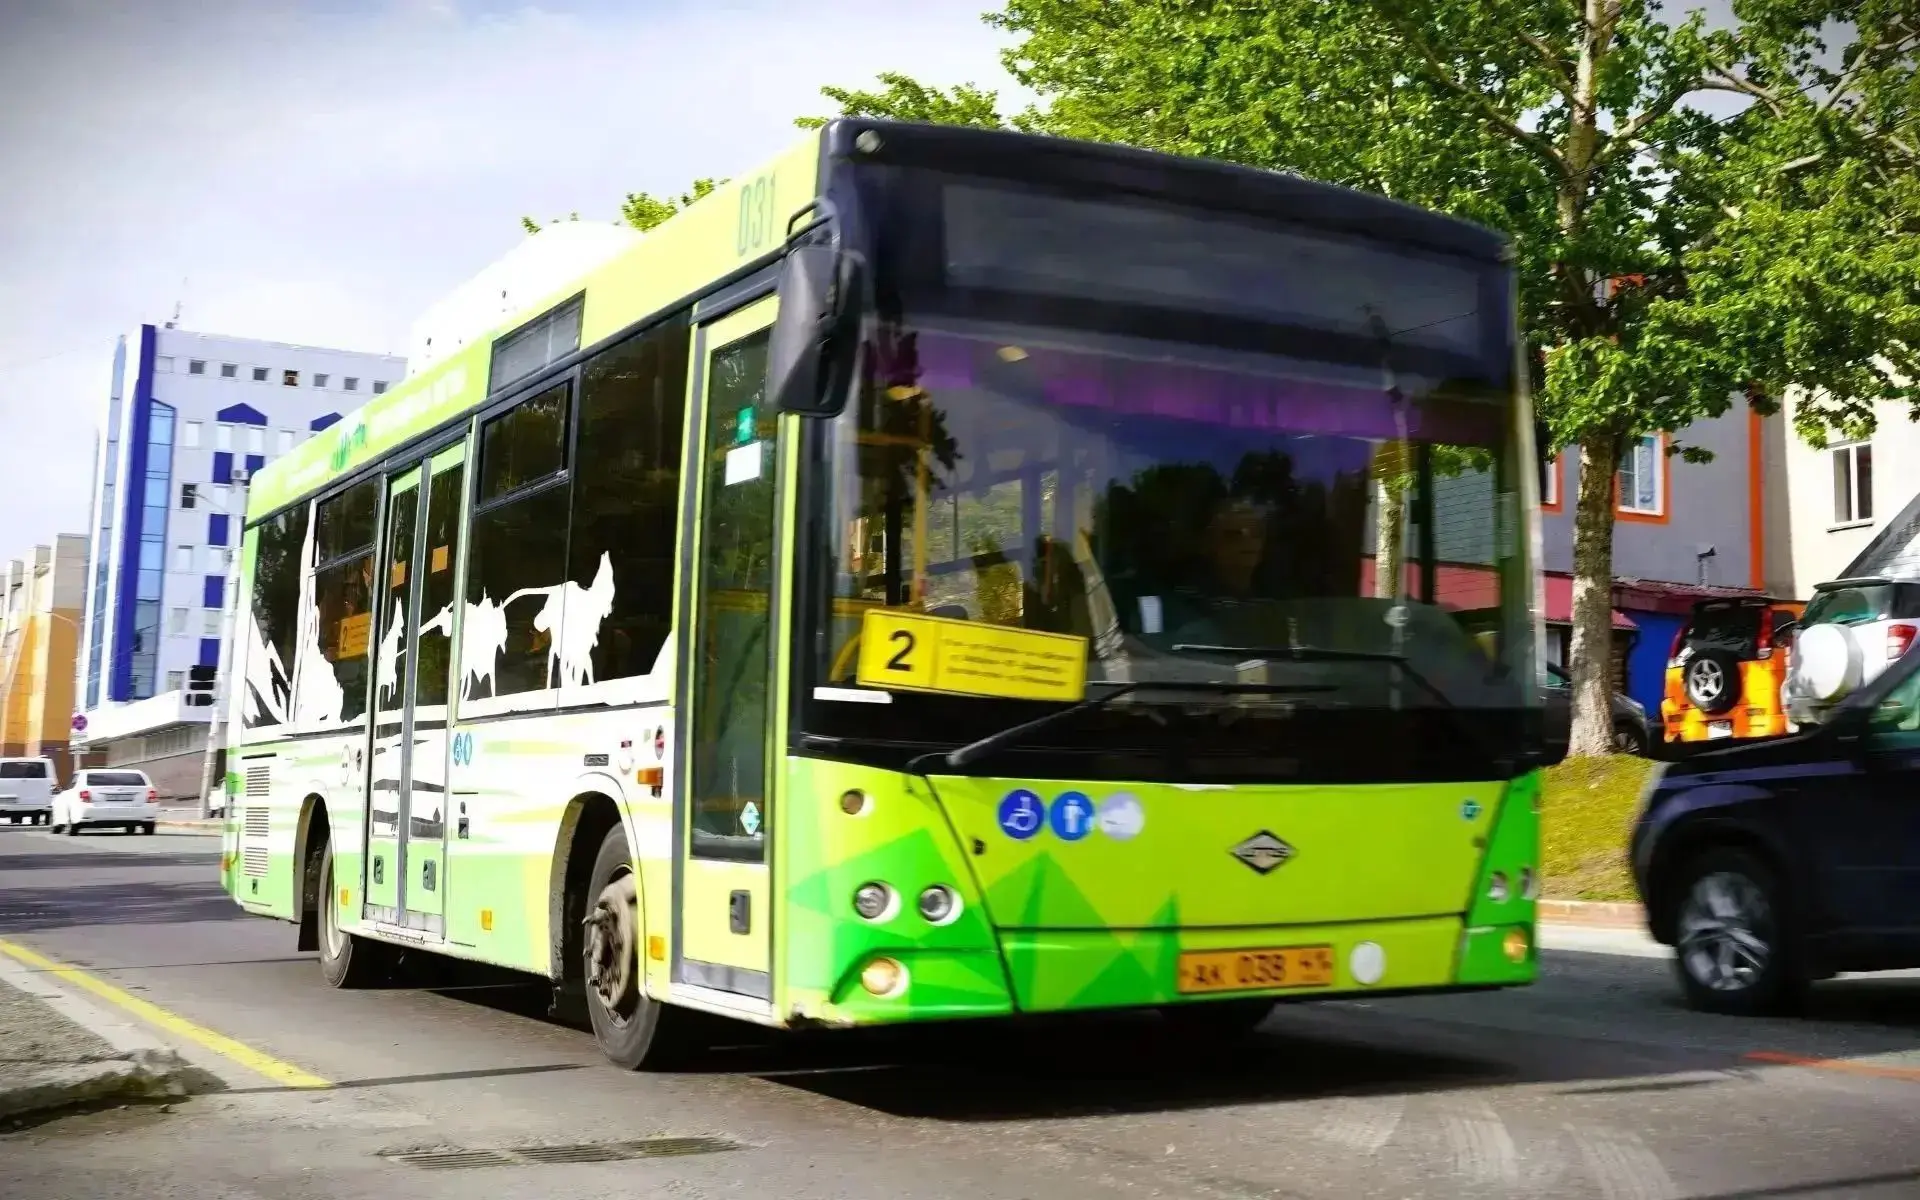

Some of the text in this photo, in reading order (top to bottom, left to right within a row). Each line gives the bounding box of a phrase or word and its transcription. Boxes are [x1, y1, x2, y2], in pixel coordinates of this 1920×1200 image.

[738, 171, 776, 257] 031
[342, 625, 348, 652] 2
[886, 629, 917, 672] 2
